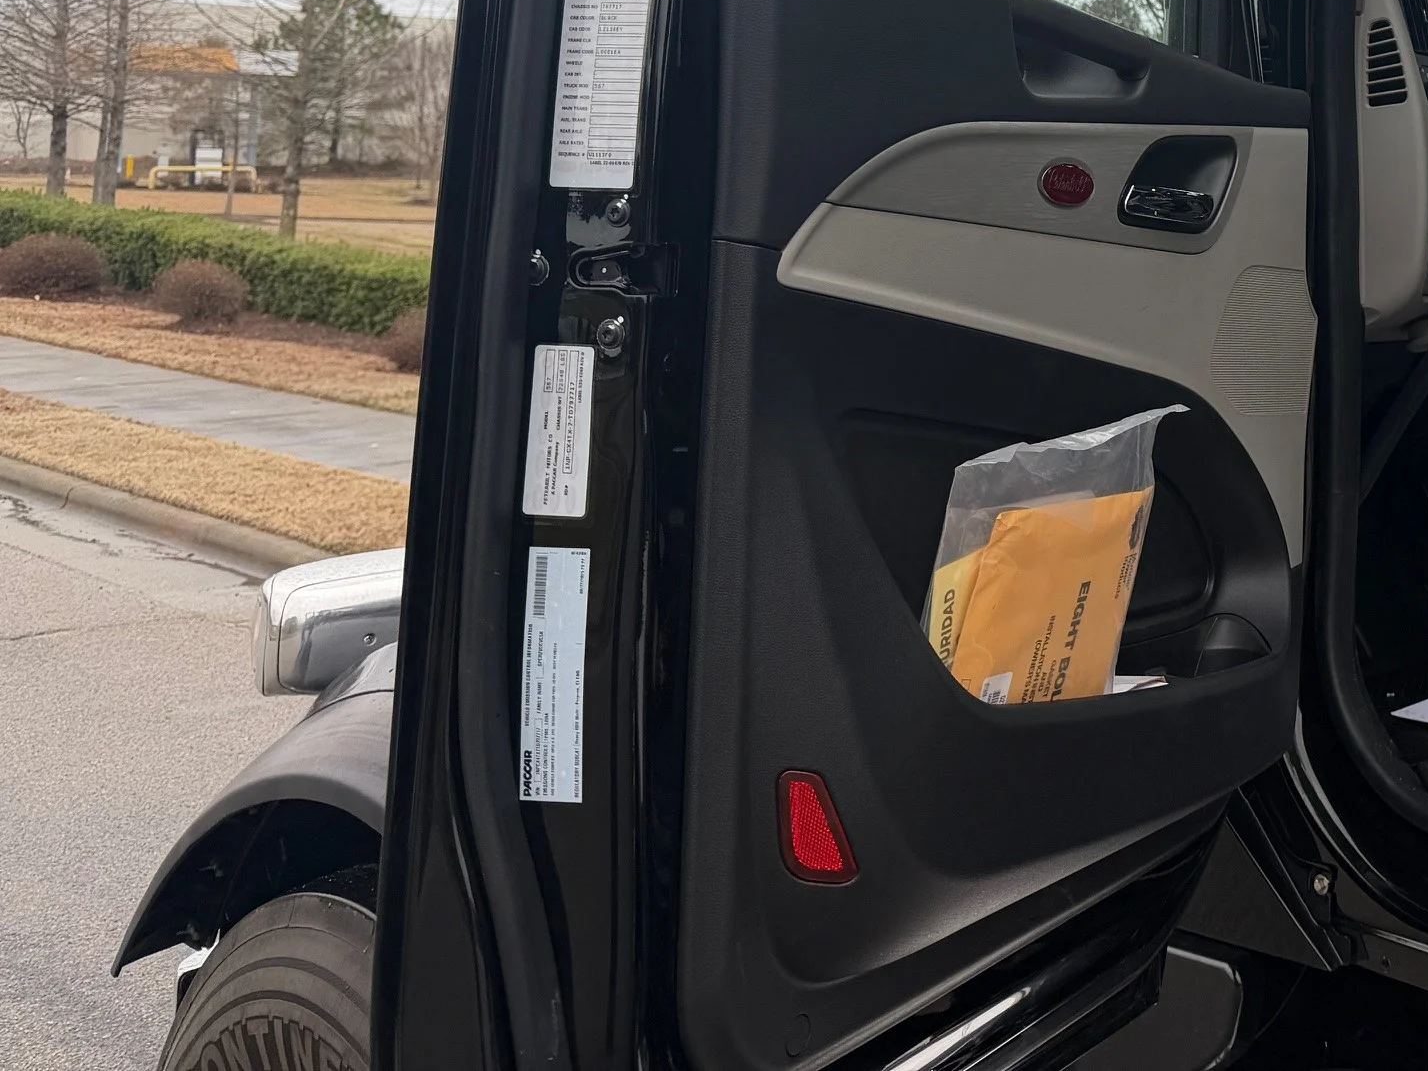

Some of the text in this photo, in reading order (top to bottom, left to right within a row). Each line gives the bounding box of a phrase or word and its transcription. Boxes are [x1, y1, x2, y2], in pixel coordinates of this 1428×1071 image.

[552, 441, 560, 466] Company
[940, 589, 955, 662] URIDAD
[1063, 580, 1092, 650] EIGHT
[1033, 615, 1056, 682] INSTALLATION
[1037, 672, 1047, 692] AND
[522, 750, 532, 796] PACCAR
